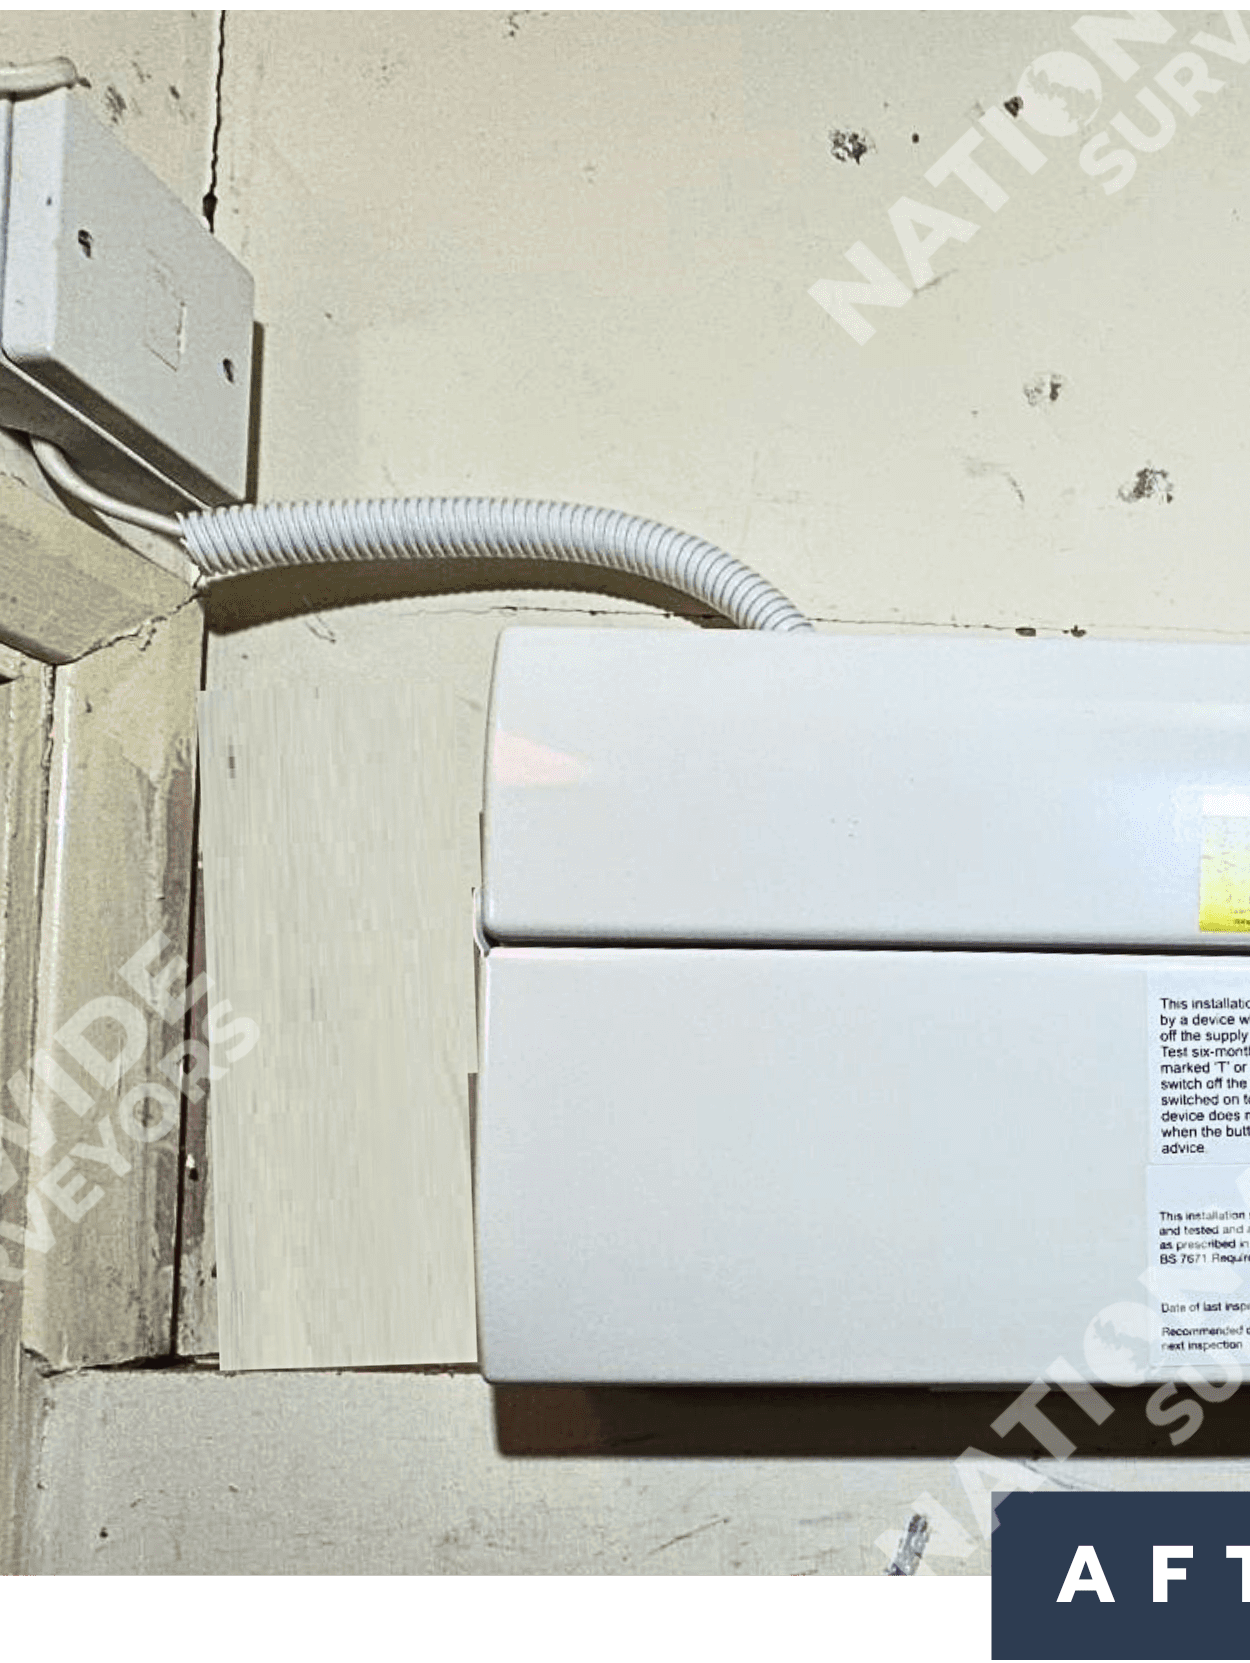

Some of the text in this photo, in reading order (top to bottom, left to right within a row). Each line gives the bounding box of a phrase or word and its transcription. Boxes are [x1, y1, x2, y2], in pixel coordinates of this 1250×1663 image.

[1161, 998, 1188, 1010] This
[1160, 1014, 1176, 1029] by
[1180, 1016, 1188, 1026] a
[1192, 1014, 1235, 1026] device
[1159, 1029, 1177, 1042] off
[1181, 1030, 1201, 1041] the
[1205, 1029, 1248, 1044] supply
[1161, 1045, 1188, 1058] Test
[1160, 1062, 1210, 1074] marked
[1233, 1064, 1247, 1073] or
[1161, 1077, 1202, 1090] switch
[1206, 1077, 1223, 1089] off
[1226, 1078, 1247, 1089] the
[1161, 1094, 1219, 1106] switched
[1223, 1096, 1239, 1105] on
[1161, 1110, 1205, 1122] device
[1209, 1110, 1240, 1122] does
[1161, 1126, 1197, 1138] when
[1201, 1125, 1222, 1138] the
[1159, 1211, 1183, 1221] This
[1186, 1211, 1245, 1220] installation
[1159, 1225, 1180, 1236] and
[1184, 1226, 1219, 1235] tested
[1223, 1225, 1243, 1234] and
[1160, 1242, 1173, 1250] as
[1176, 1239, 1236, 1252] prescribed
[1160, 1251, 1178, 1264] BS
[1181, 1253, 1206, 1264] 7671
[1161, 1303, 1186, 1313] Date
[1189, 1302, 1200, 1312] of
[1203, 1301, 1221, 1311] last
[1162, 1325, 1244, 1336] Recommended
[1188, 1340, 1243, 1352] inspection
